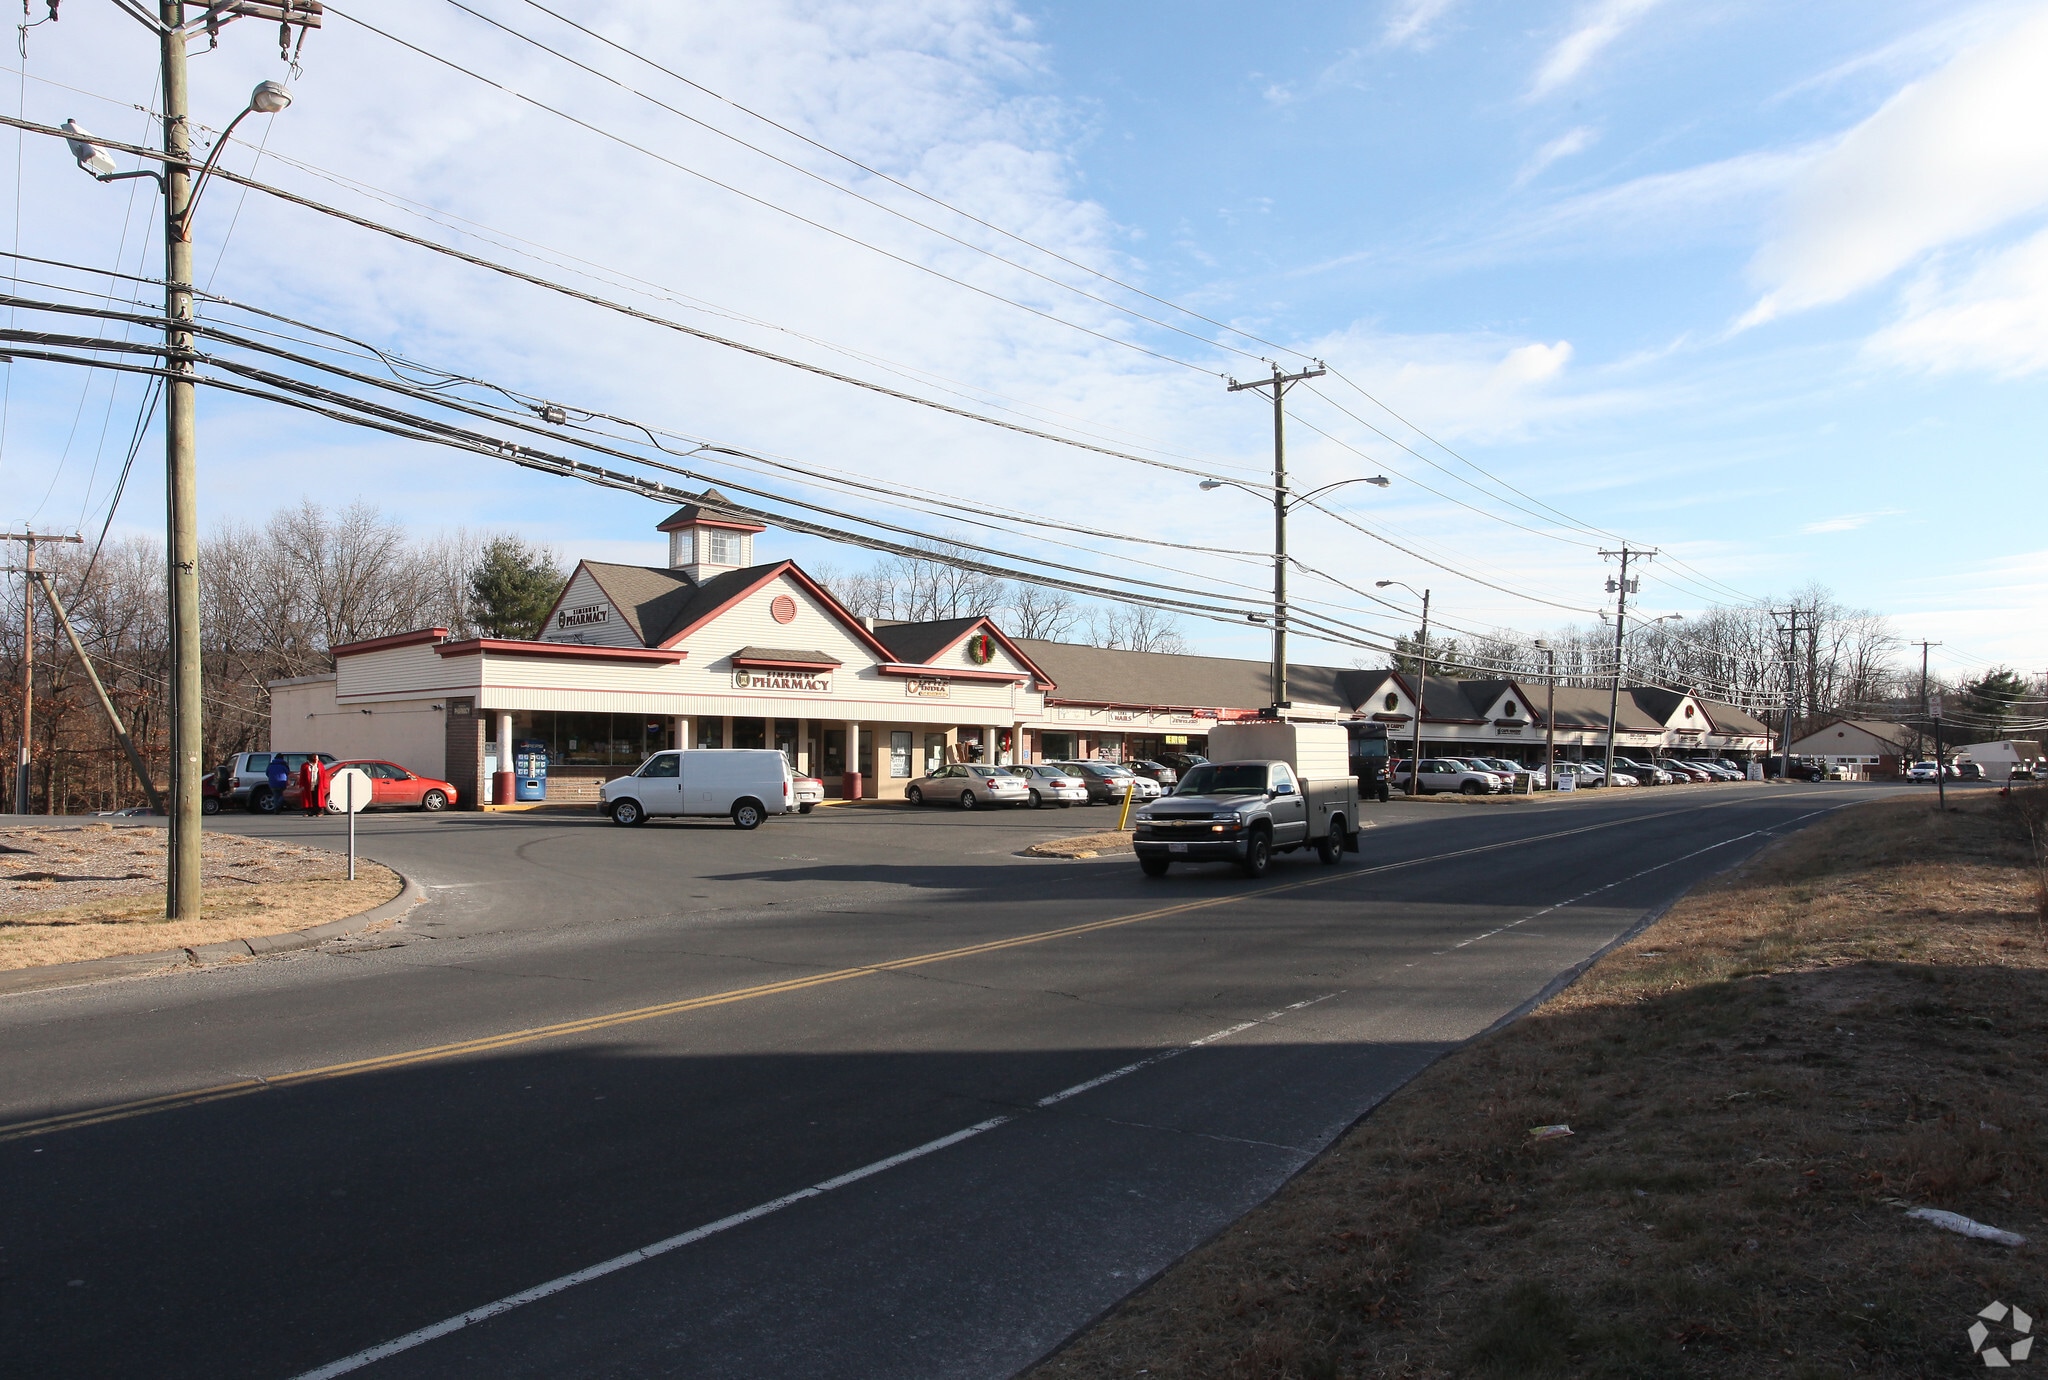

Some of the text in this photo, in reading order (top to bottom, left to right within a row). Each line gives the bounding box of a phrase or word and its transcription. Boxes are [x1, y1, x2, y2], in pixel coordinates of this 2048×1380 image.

[566, 611, 607, 626] PHARMACY
[767, 671, 817, 680] SIMSBURY
[752, 677, 829, 691] PHARMACY
